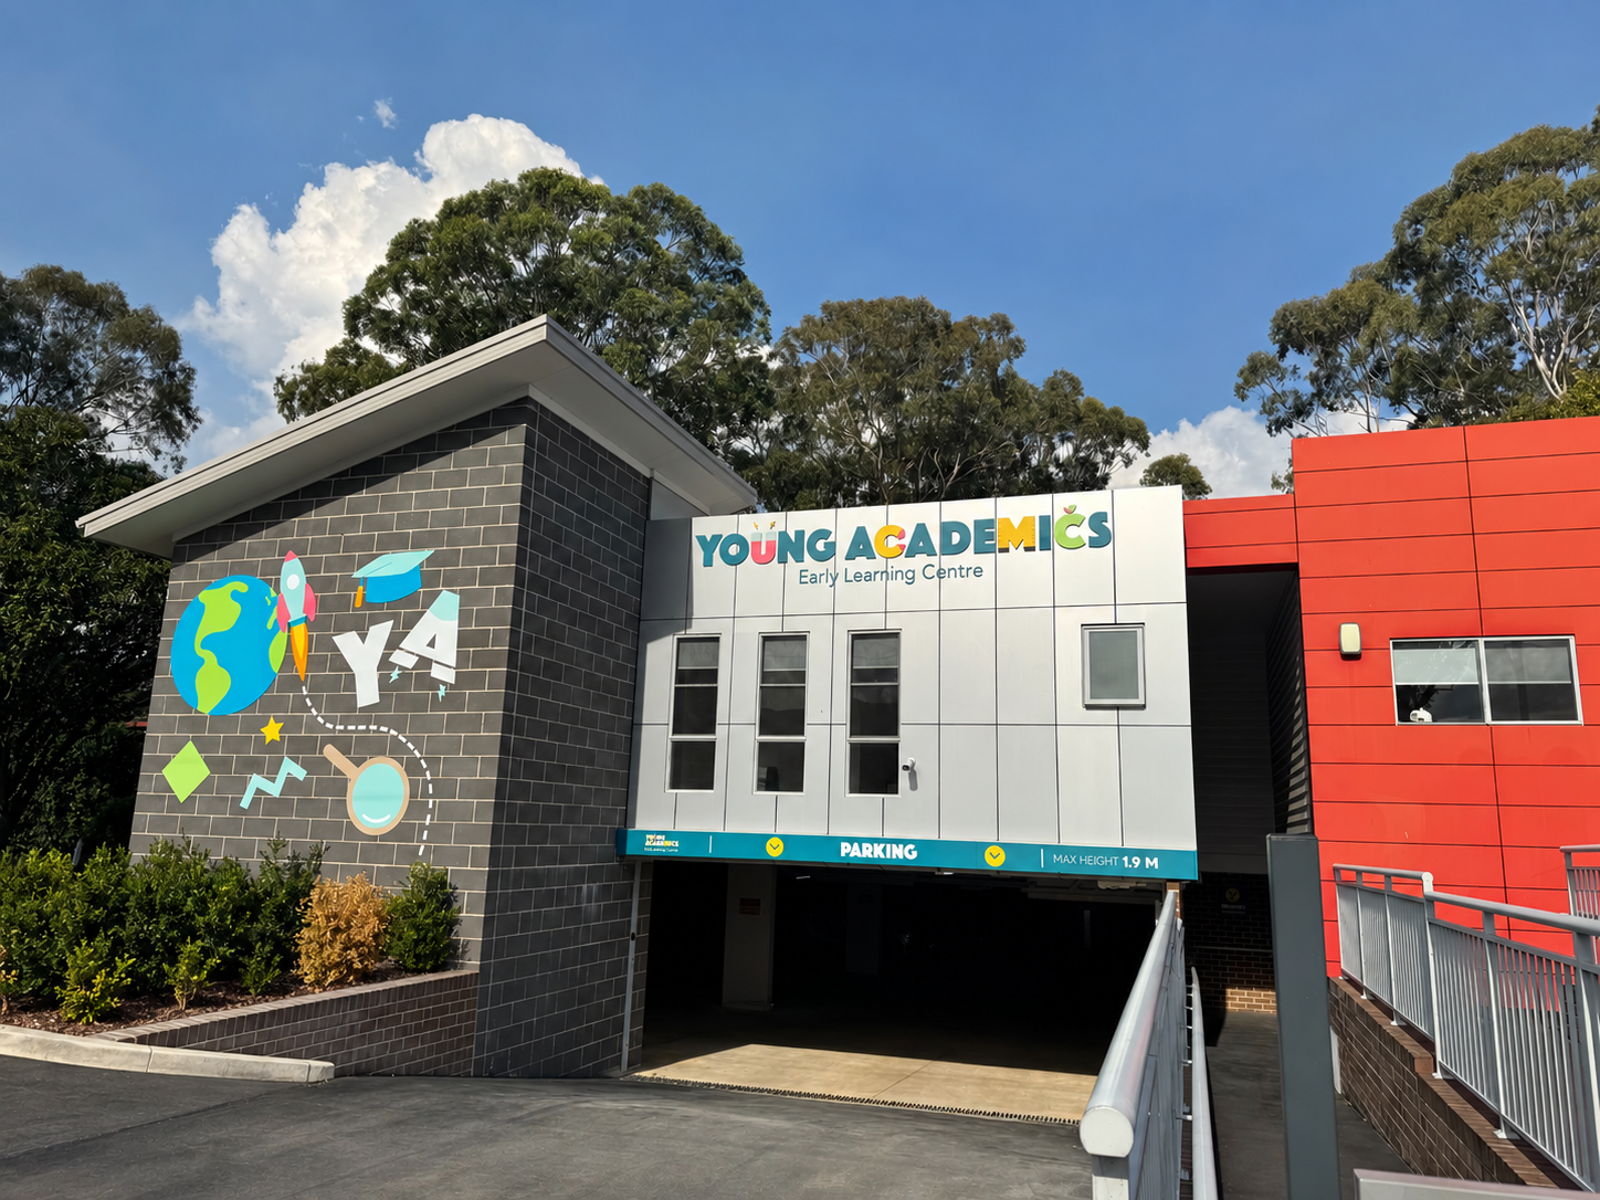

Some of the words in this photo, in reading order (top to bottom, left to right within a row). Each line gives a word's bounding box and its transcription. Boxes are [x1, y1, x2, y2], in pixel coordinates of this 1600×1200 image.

[695, 528, 836, 567] YOUNG
[844, 510, 1112, 561] ACADEMICS
[799, 567, 839, 588] Early
[844, 565, 916, 586] Learning
[922, 563, 983, 581] Centre
[840, 841, 918, 860] PARKING
[1052, 854, 1077, 865] MAX
[1079, 856, 1119, 867] HEIGHT
[1122, 855, 1141, 869] 1.9
[1145, 857, 1159, 870] M
